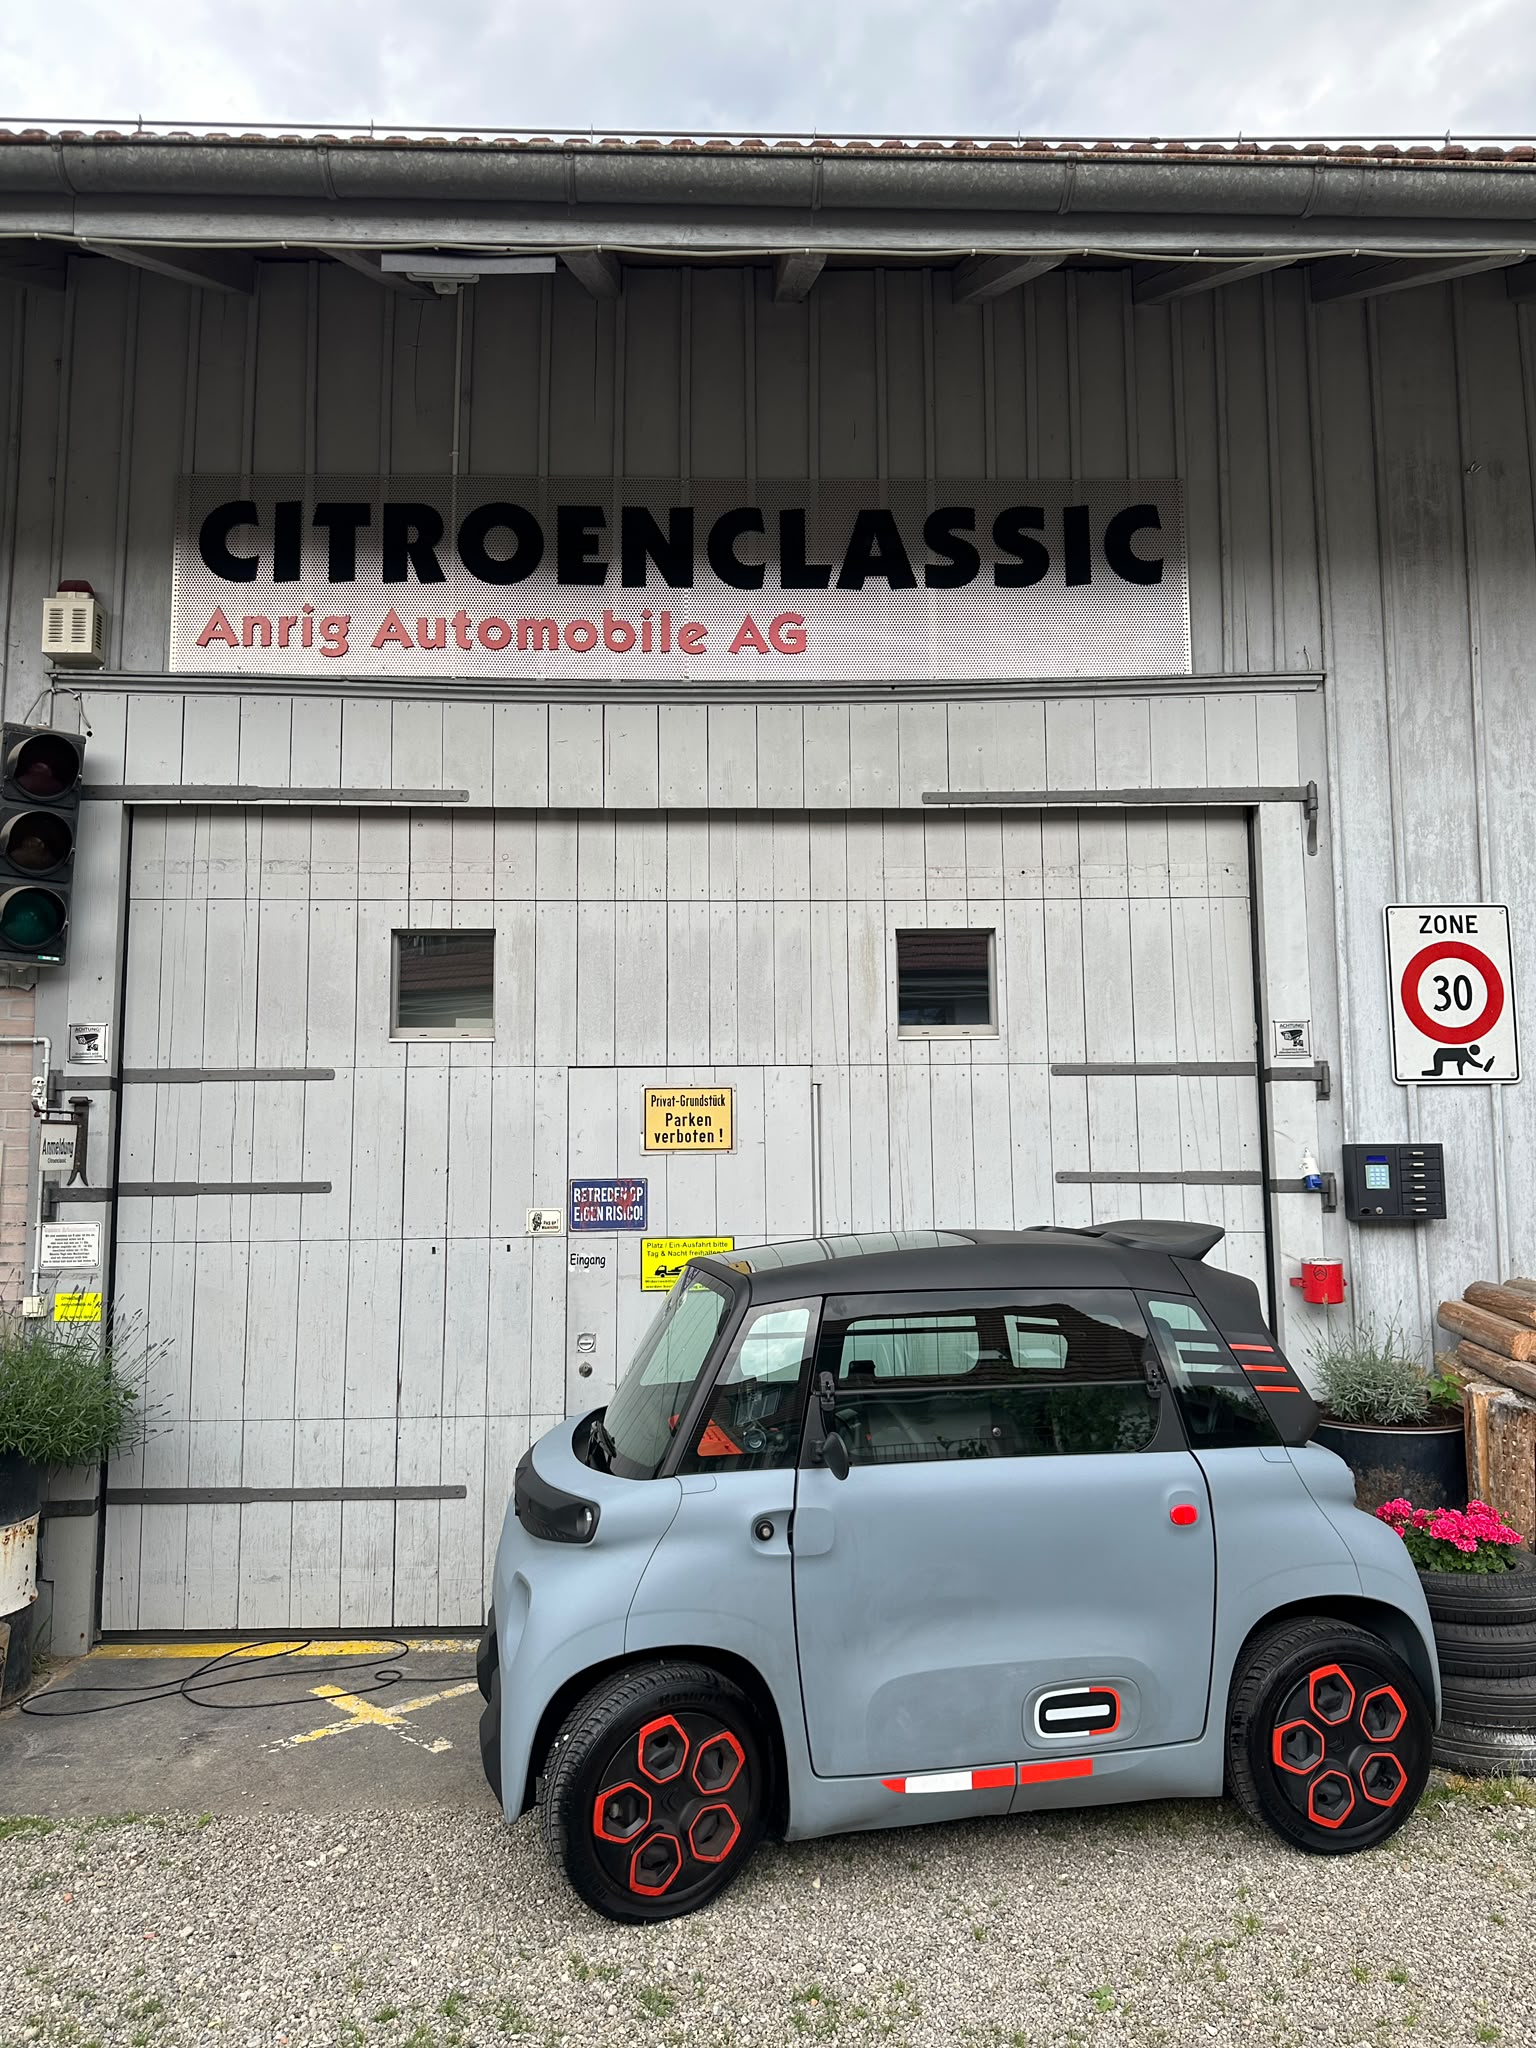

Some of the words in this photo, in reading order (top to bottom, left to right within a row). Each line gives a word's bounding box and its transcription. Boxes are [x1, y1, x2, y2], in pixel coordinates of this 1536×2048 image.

[199, 500, 1164, 591] CITROENCLASSIC
[196, 604, 352, 658] Anrig
[371, 607, 709, 655] Automobile
[728, 613, 808, 656] AG
[1418, 914, 1479, 934] ZONE
[1432, 974, 1473, 1012] 30
[650, 1093, 726, 1108] Privat-Grundstück
[665, 1112, 712, 1127] Parken
[654, 1128, 715, 1144] verboten
[668, 1241, 712, 1249] Ein-Ausfahrt
[569, 1252, 606, 1269] Eingang
[647, 1250, 659, 1258] Tag
